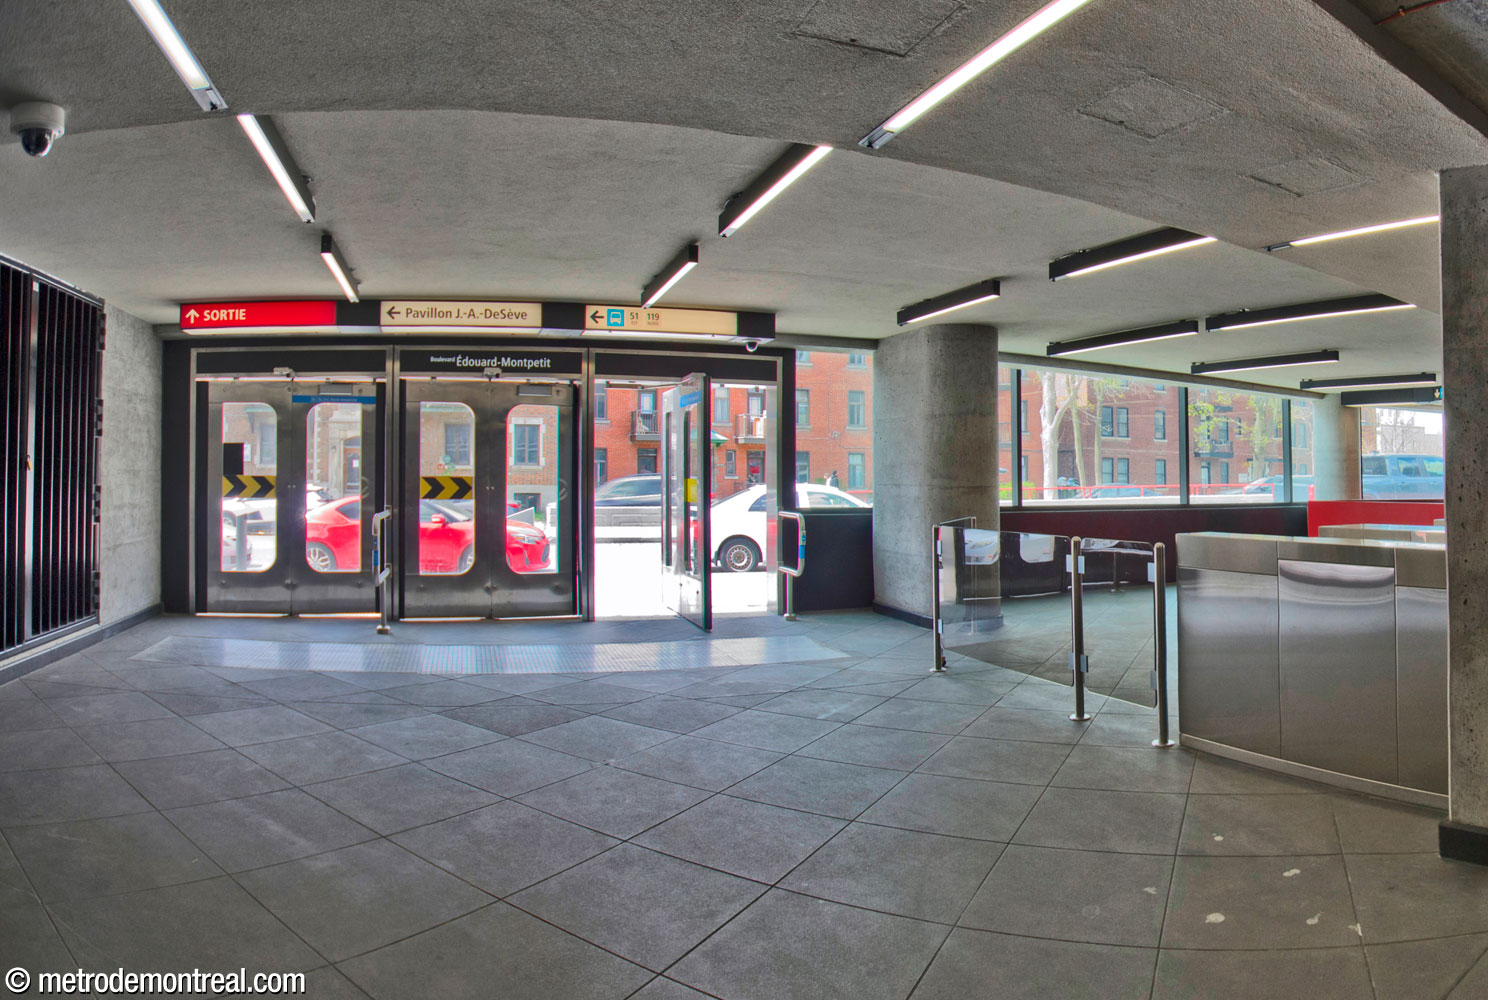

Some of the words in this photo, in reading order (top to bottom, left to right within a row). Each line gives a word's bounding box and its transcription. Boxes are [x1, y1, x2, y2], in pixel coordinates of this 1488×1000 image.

[203, 309, 247, 322] SORTIE
[405, 307, 453, 319] Pavillon
[455, 308, 528, 320] J.-A.-DeSève
[630, 312, 639, 320] 51
[647, 313, 660, 321] 119
[456, 354, 552, 370] Édouard-Montpetit
